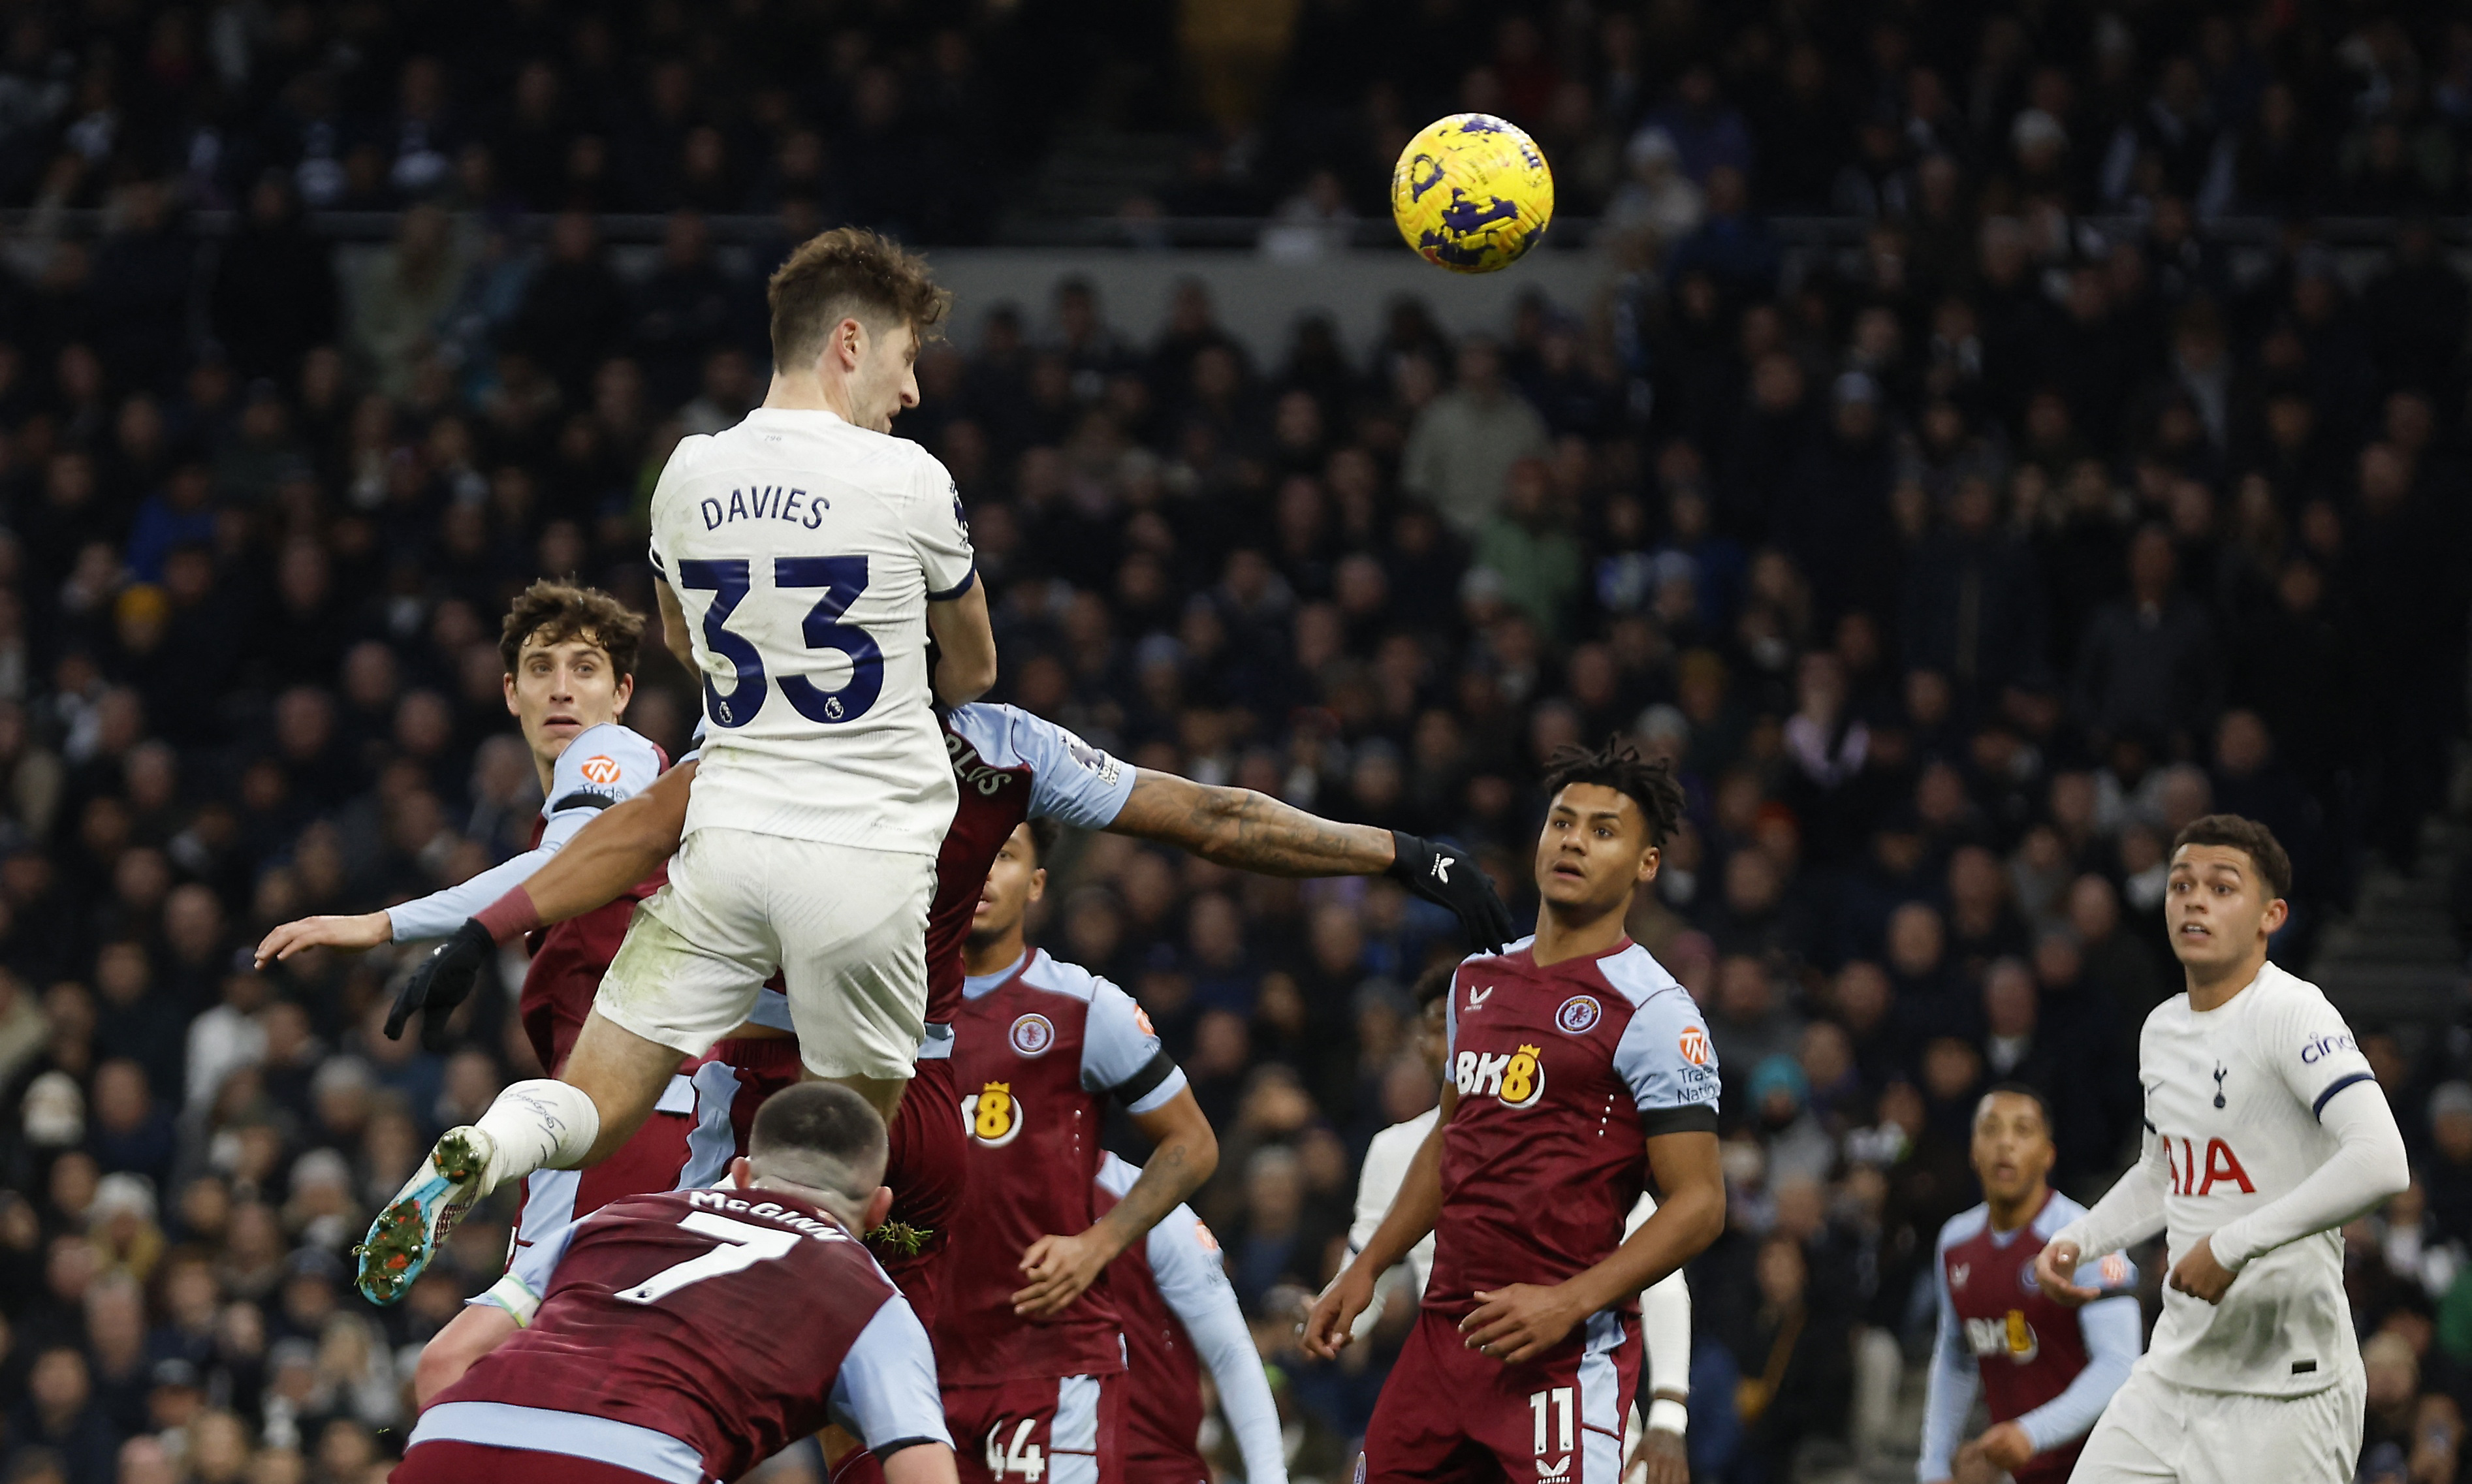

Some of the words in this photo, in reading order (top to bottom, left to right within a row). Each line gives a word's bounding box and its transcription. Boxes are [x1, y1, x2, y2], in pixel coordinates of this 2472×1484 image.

[700, 485, 831, 531] DAVIES
[677, 555, 885, 727] 33
[1456, 1050, 1536, 1103] BK8
[1679, 1032, 1707, 1062] TN
[689, 1191, 849, 1242] McGINN
[614, 1210, 803, 1306] 7
[985, 1418, 1045, 1483] 44
[1530, 1387, 1574, 1455] 11
